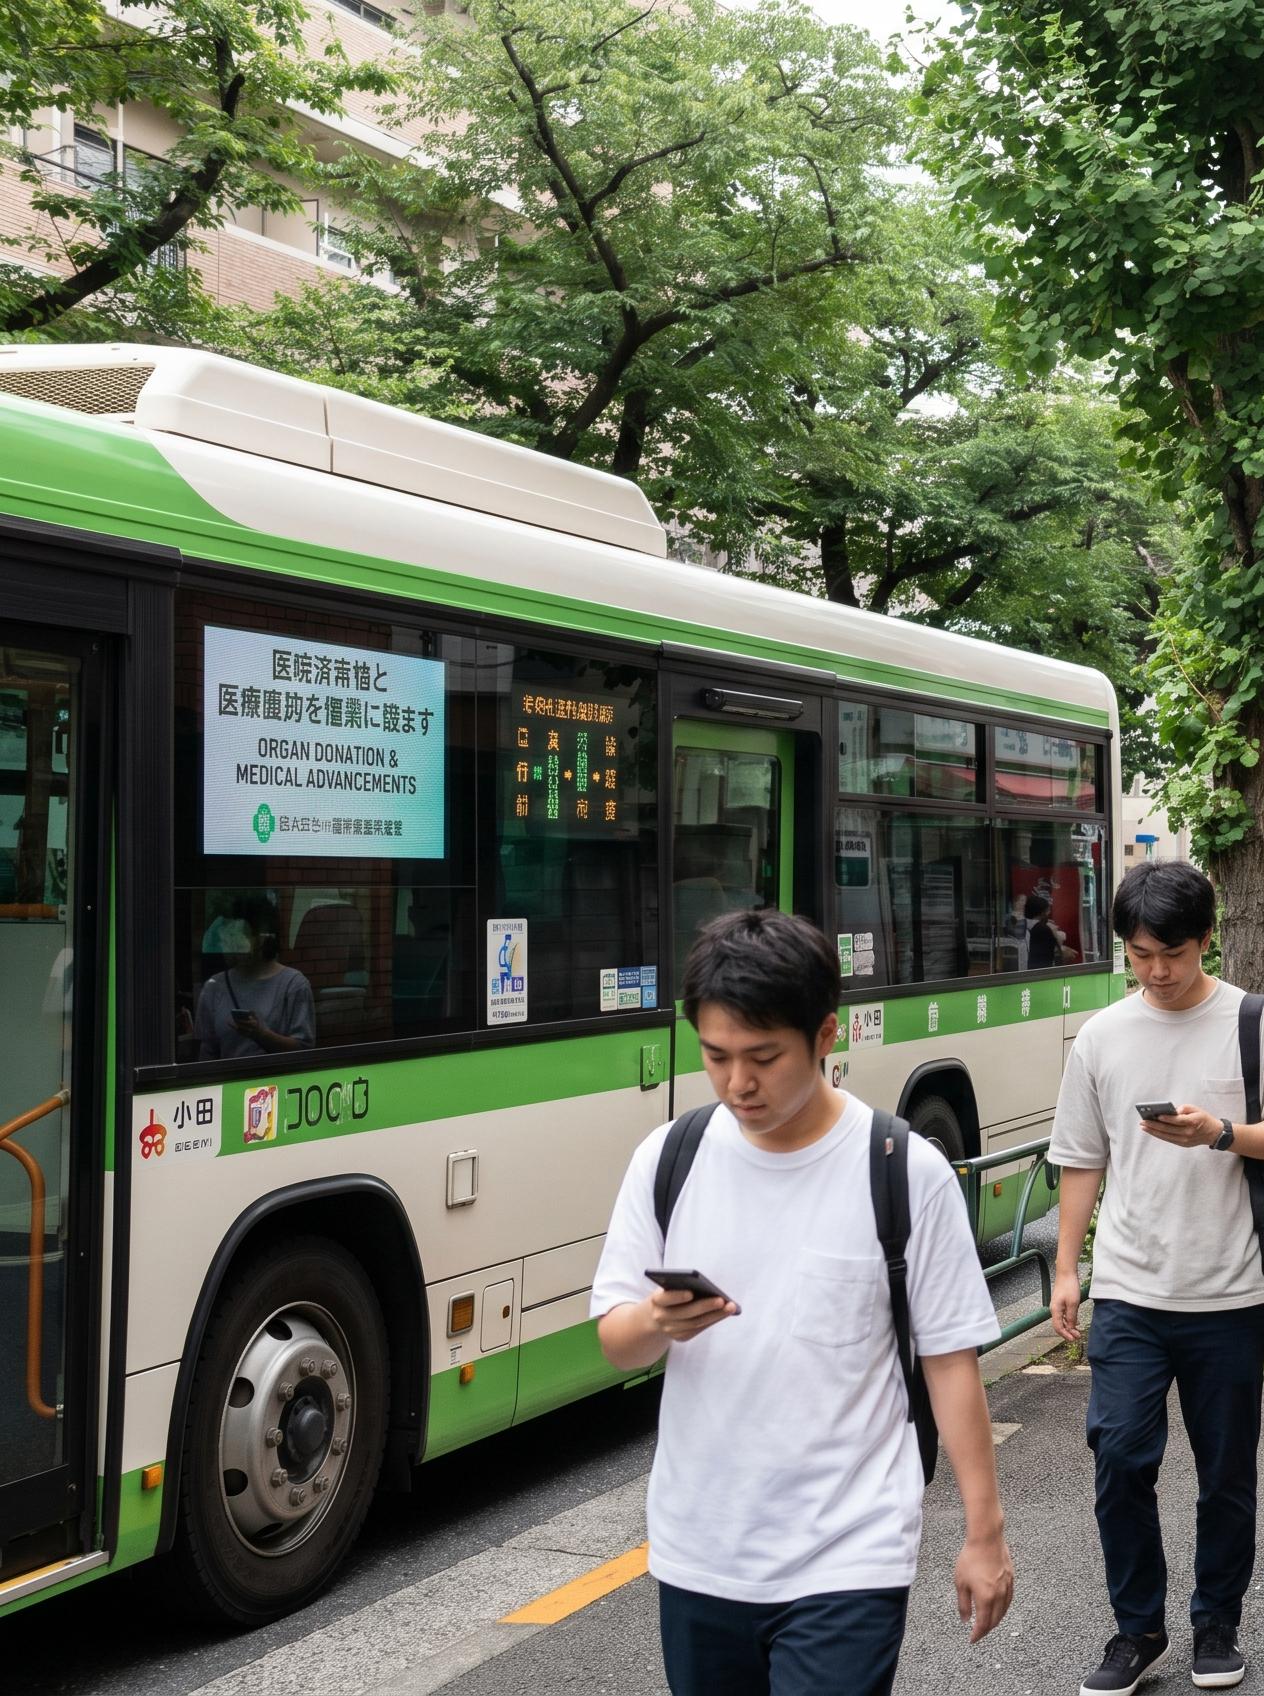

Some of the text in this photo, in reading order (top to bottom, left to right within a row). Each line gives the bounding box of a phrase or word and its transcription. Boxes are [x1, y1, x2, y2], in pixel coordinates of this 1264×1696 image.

[258, 738, 399, 769] ORGAN DONATION &
[236, 763, 417, 795] MEDICAL ADVANCEMENTS
[173, 1098, 213, 1129] 小田
